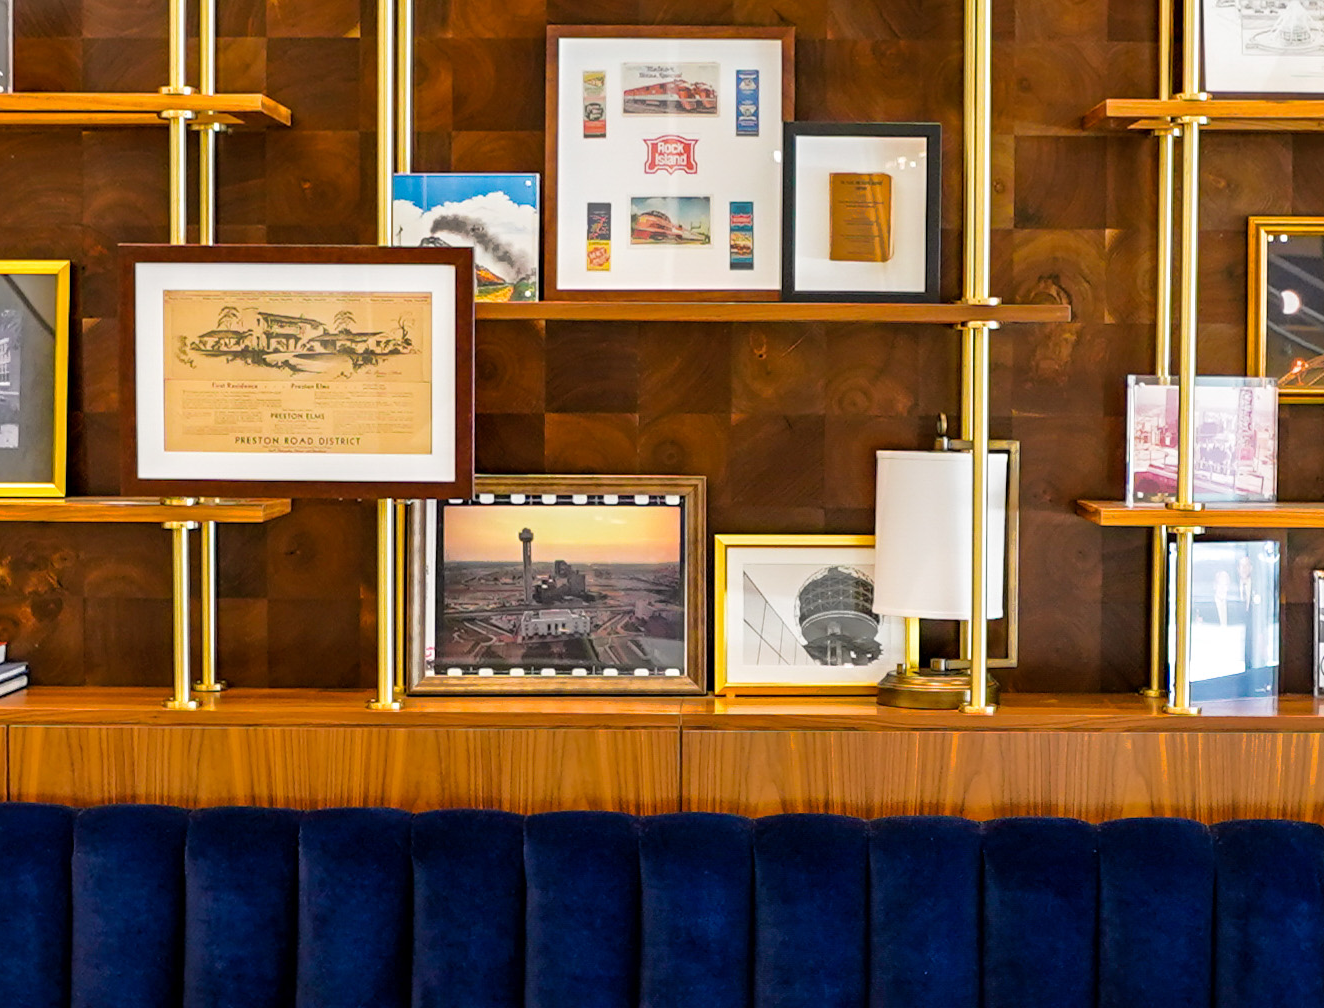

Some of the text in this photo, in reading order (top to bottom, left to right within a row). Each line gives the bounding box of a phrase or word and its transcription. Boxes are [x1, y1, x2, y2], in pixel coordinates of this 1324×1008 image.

[657, 142, 685, 154] Rock
[655, 153, 687, 166] Island
[270, 412, 303, 420] PRESTON
[235, 436, 361, 446] PRESTON ROAD DISTRICT
